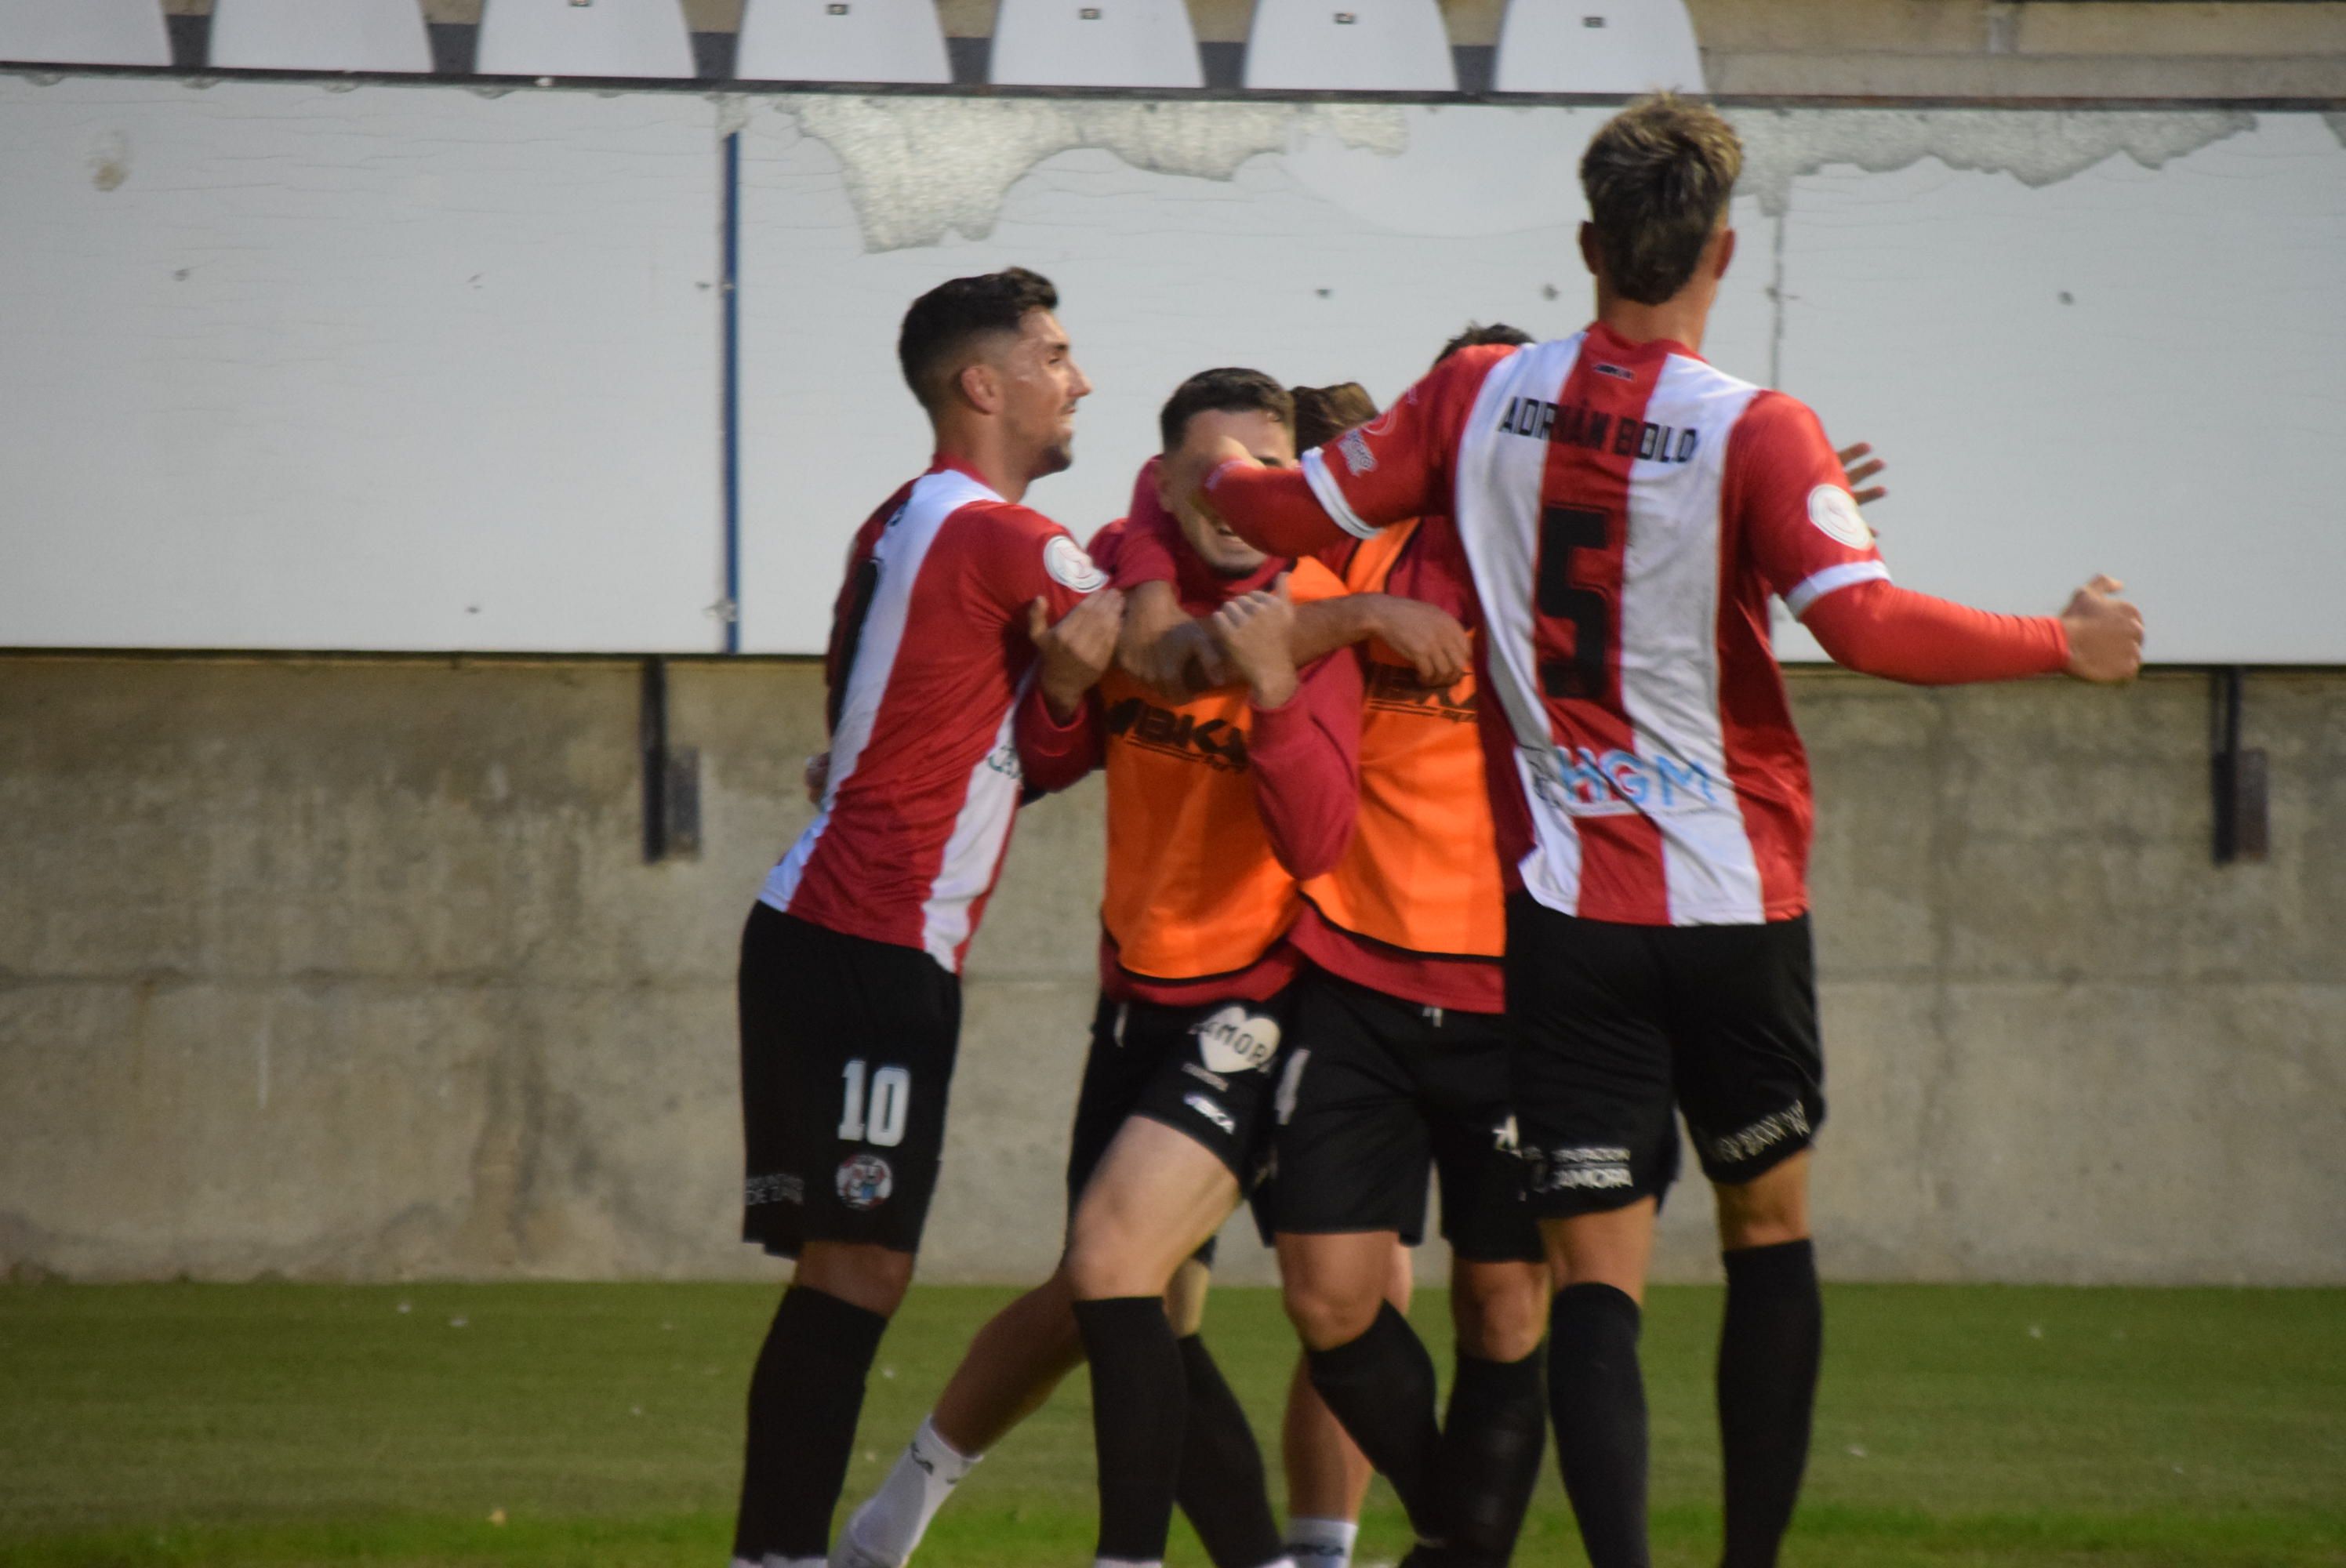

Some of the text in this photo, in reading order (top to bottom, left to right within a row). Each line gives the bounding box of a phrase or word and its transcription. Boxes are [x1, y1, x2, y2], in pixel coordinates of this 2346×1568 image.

[1613, 416, 1699, 463] BOLO
[1538, 506, 1607, 699] 5
[1556, 745, 1719, 808] HGM
[837, 1058, 910, 1147] 10
